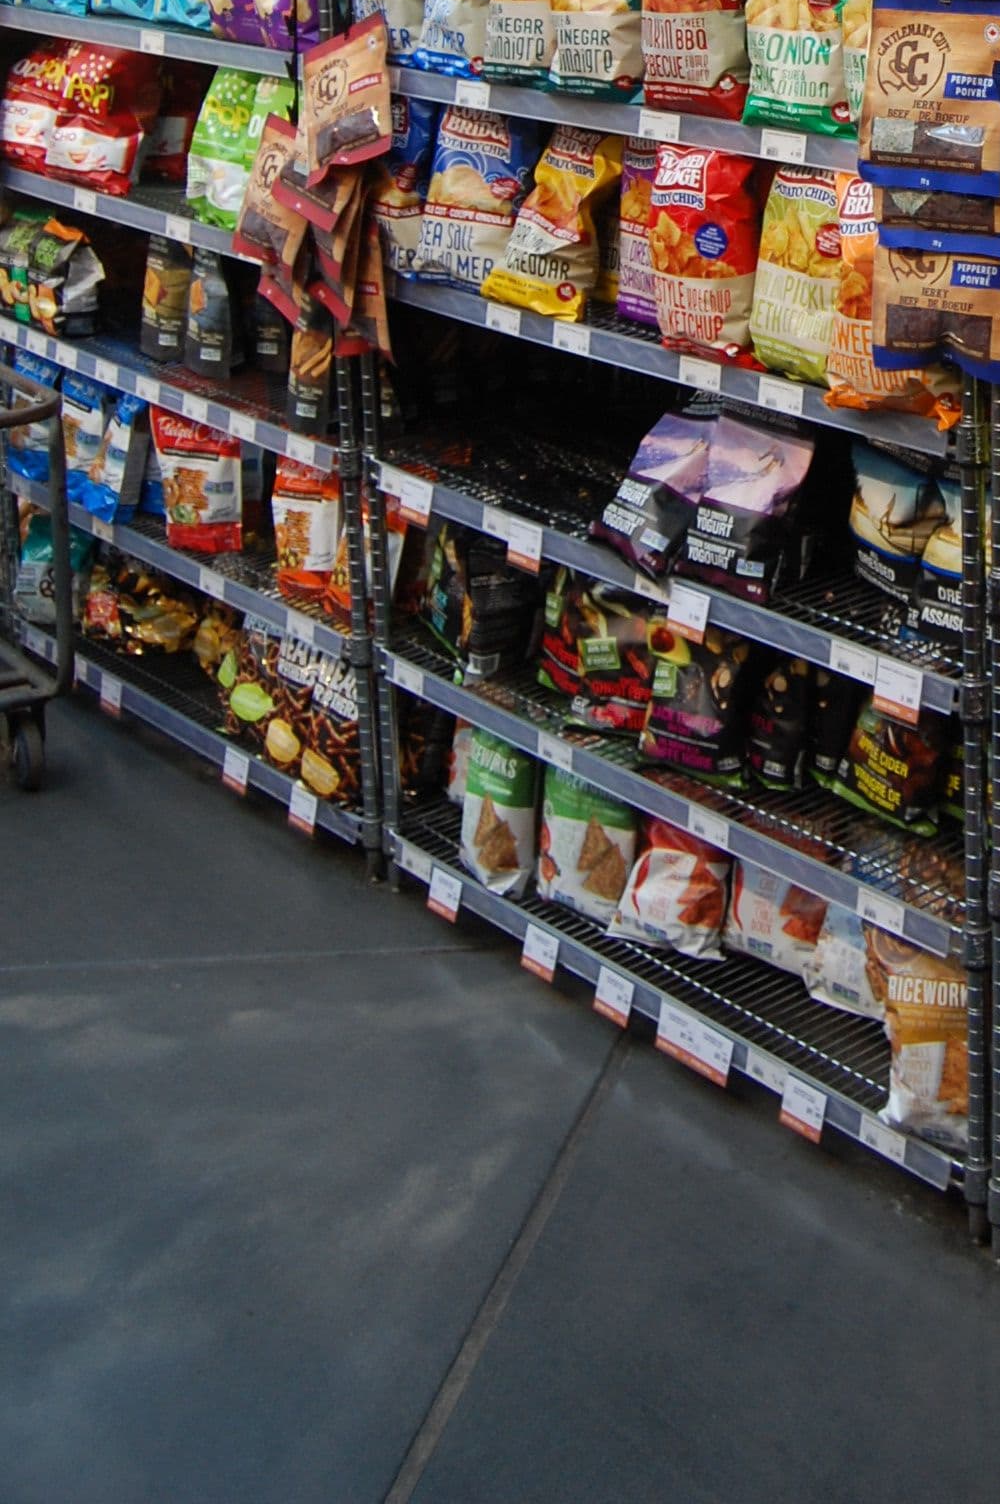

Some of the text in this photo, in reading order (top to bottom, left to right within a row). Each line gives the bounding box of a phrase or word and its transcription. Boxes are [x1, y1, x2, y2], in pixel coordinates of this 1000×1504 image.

[676, 29, 708, 50] BBQ
[950, 74, 993, 87] PEPPERED
[912, 99, 943, 111] JERKY
[887, 108, 970, 124] BEEF DE BOEUF
[671, 192, 704, 209] CHIPS
[804, 186, 836, 206] CHIPS
[957, 263, 998, 276] PEPPERED
[921, 287, 950, 298] JERKY
[927, 298, 939, 310] DE
[939, 299, 975, 312] BOEUF
[667, 312, 723, 340] KETCHUP
